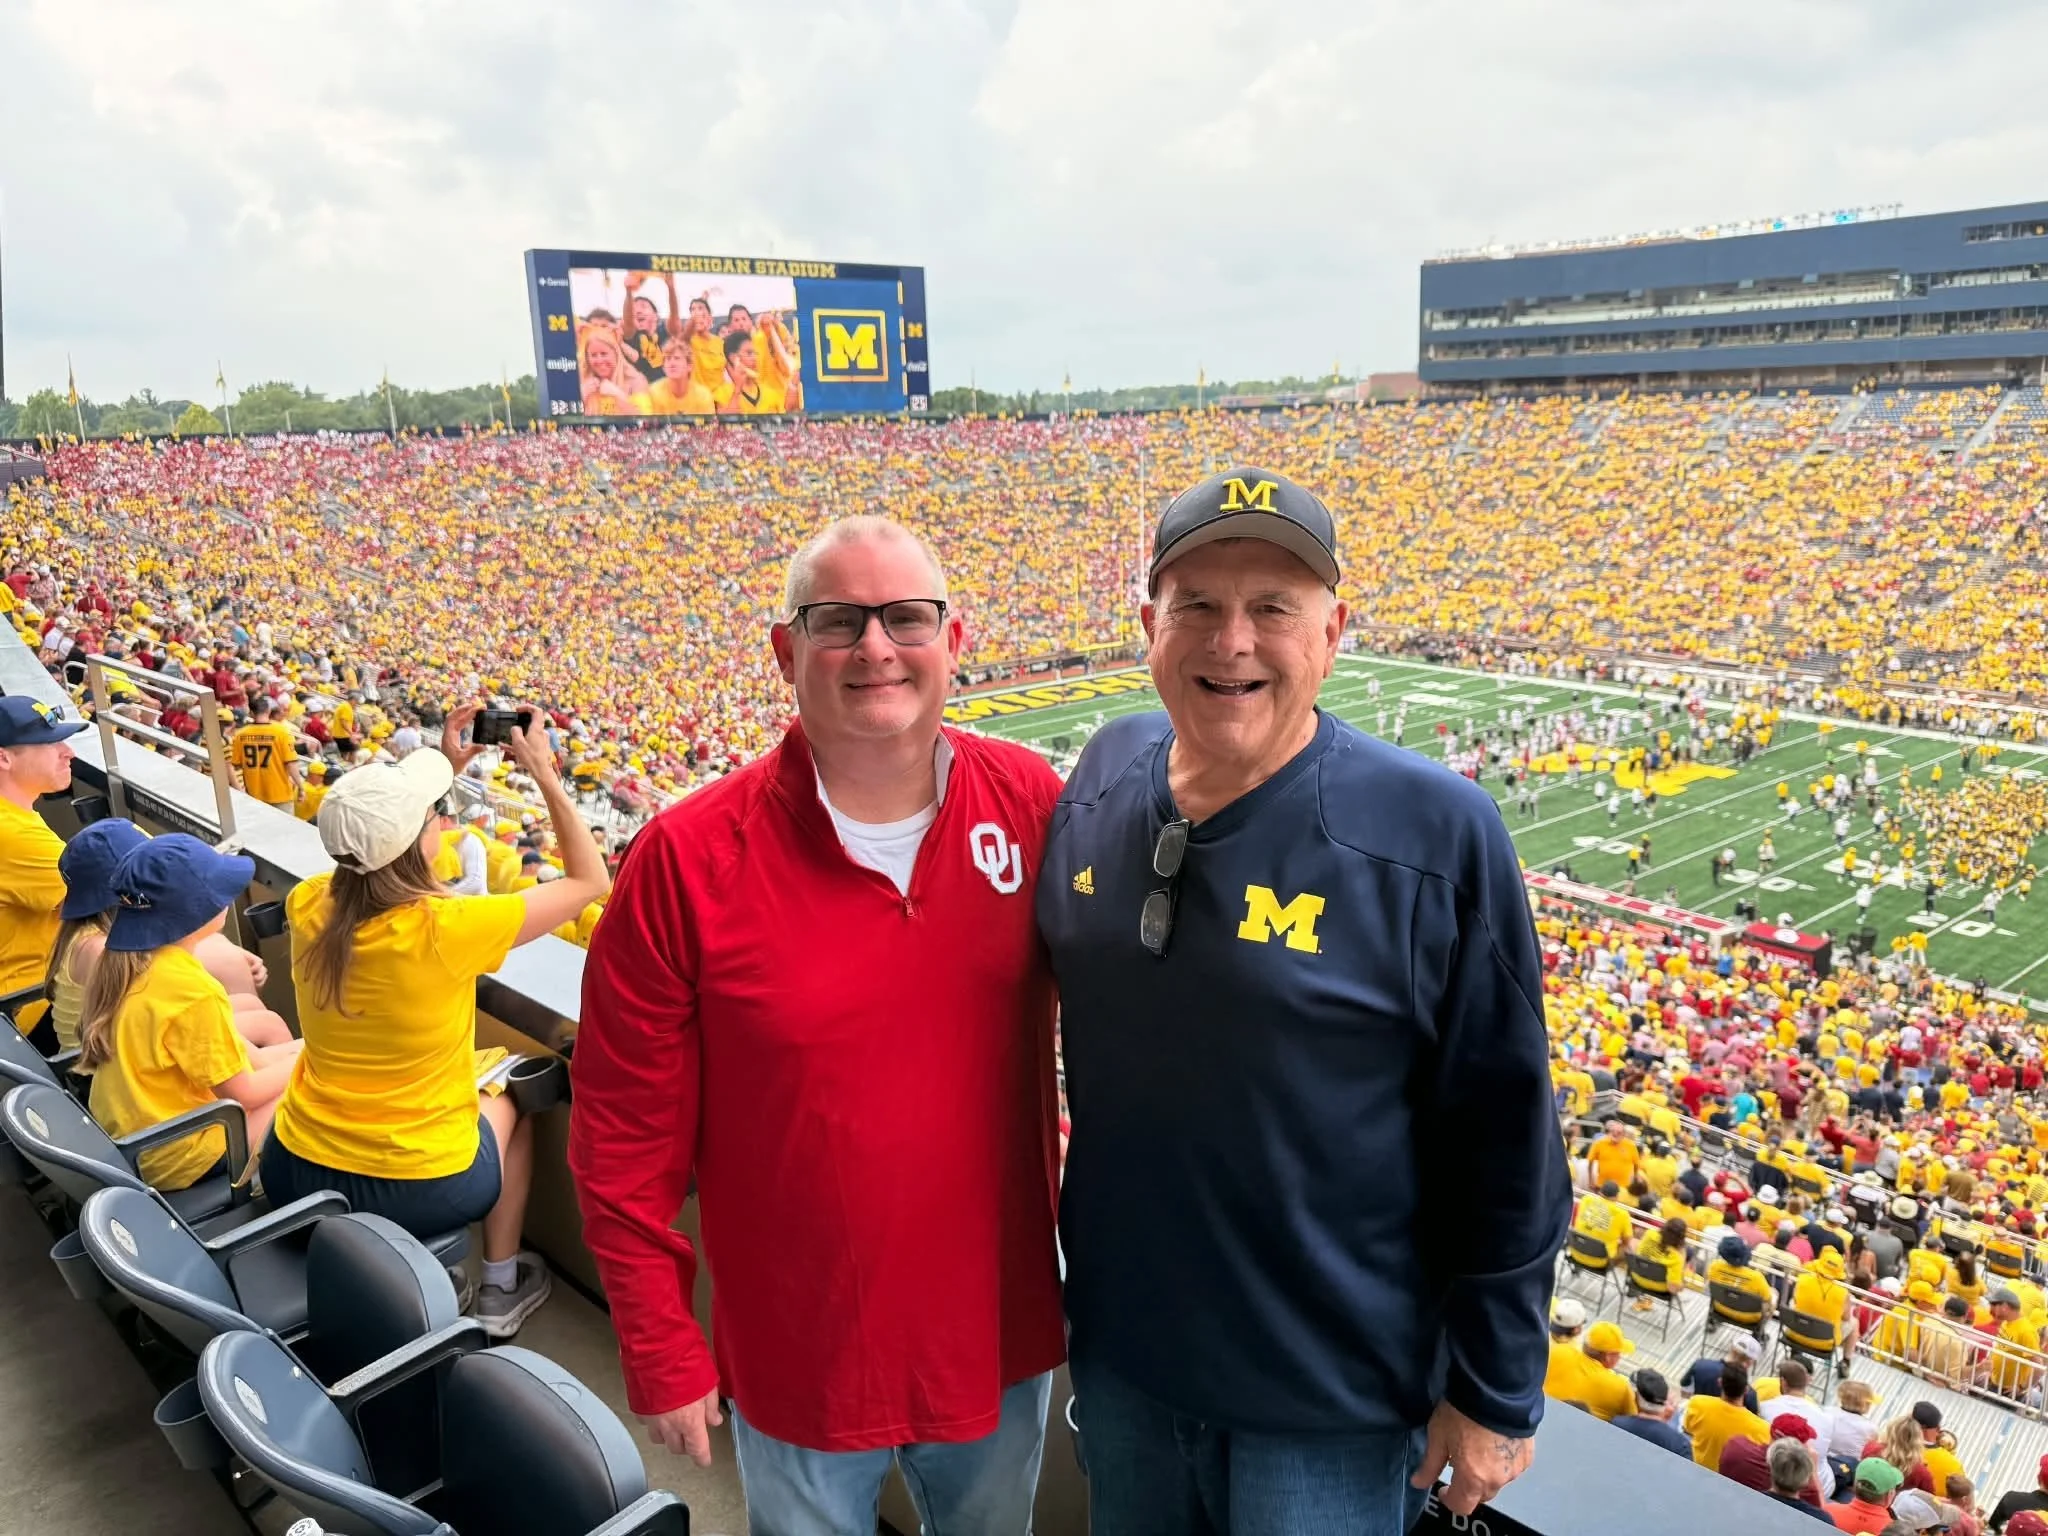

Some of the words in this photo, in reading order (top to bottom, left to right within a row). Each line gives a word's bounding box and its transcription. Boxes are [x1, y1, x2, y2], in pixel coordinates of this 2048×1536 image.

[651, 255, 750, 273] MICHIGAN
[753, 259, 836, 278] STADIUM
[548, 315, 568, 331] M
[825, 323, 878, 369] M
[1219, 478, 1279, 513] M
[243, 745, 272, 768] 97
[969, 822, 1023, 894] OU
[1072, 880, 1095, 895] adidas
[1237, 884, 1326, 954] M
